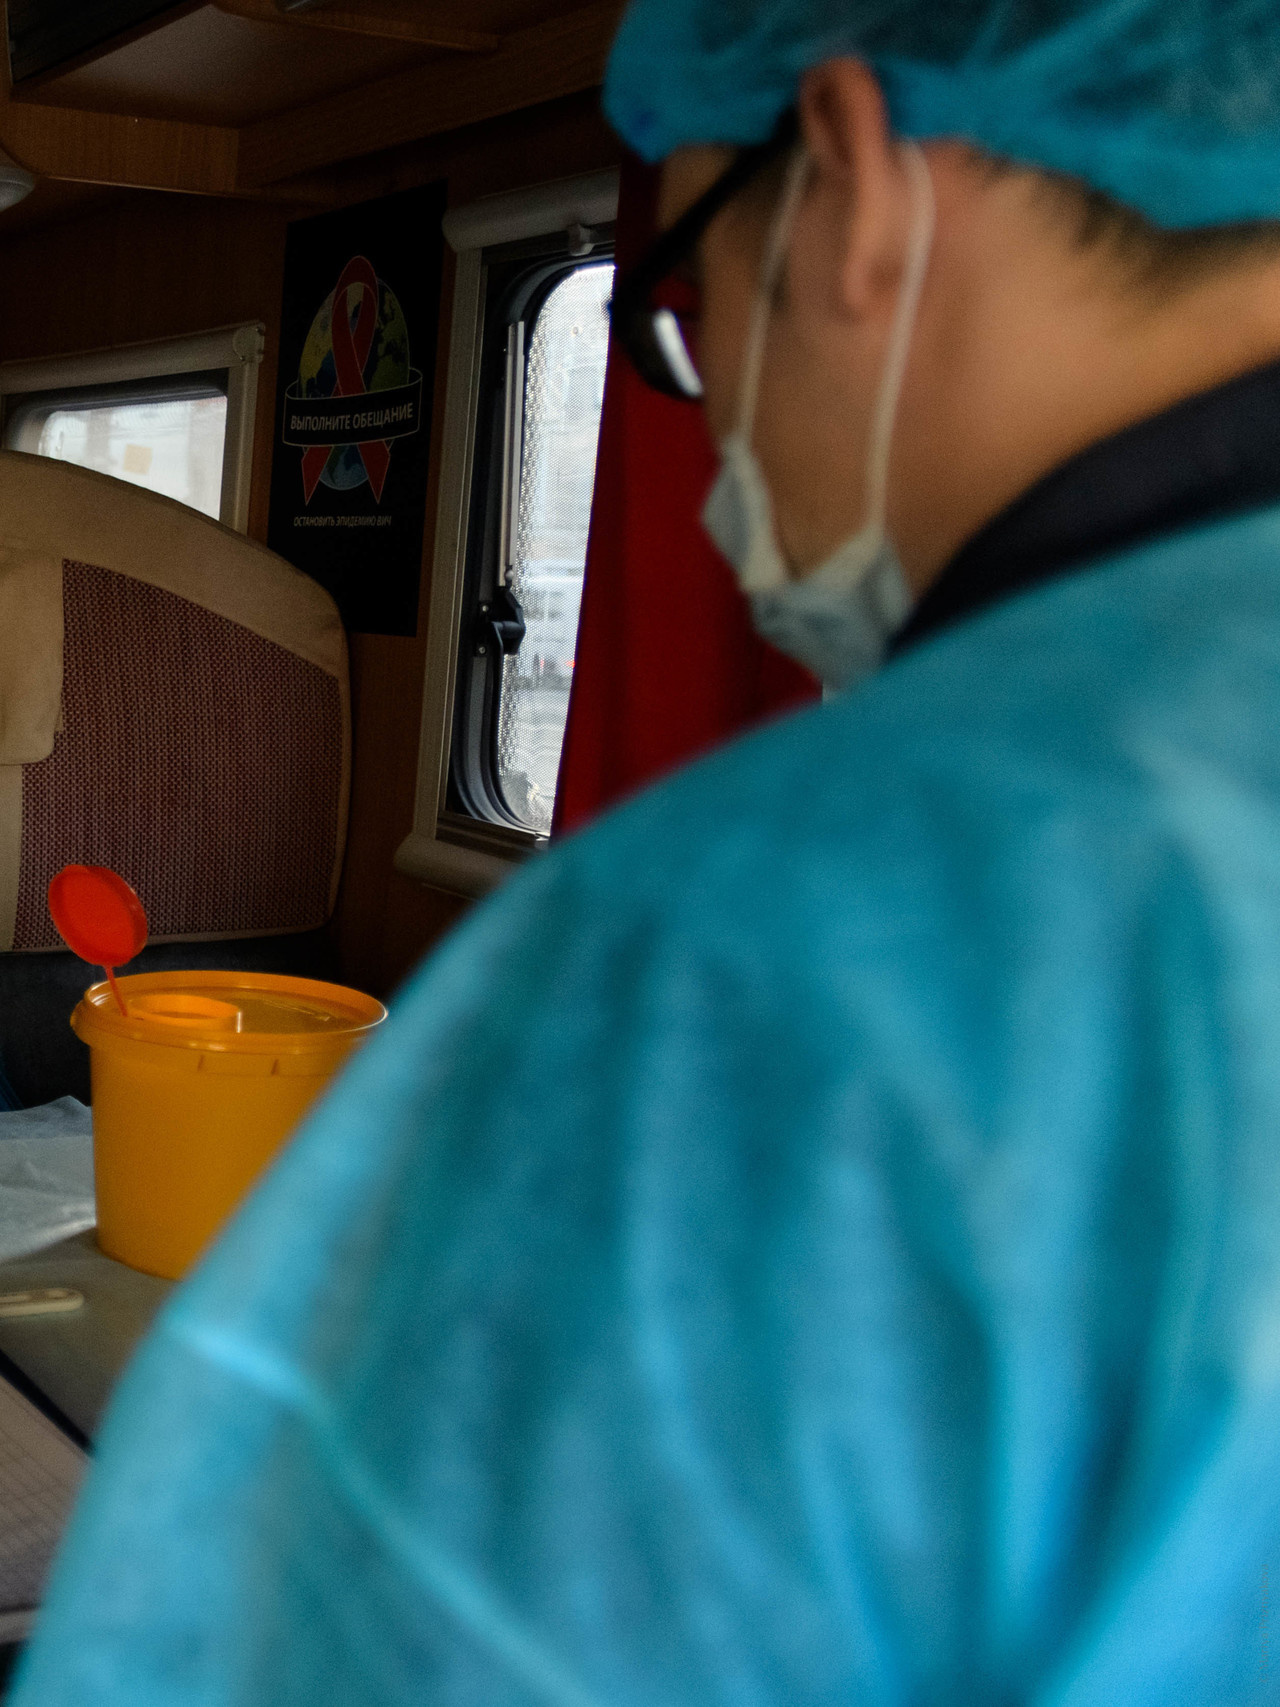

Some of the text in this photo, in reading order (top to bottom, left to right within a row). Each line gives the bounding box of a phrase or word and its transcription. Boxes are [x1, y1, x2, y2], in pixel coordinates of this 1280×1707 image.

[290, 402, 413, 431] ВЫПОЛНИТЕ ОБЕЩАНИЕ
[293, 516, 392, 527] ОСТАНОВИТЬ ЭПИДЕМИЮ ВИЧ
